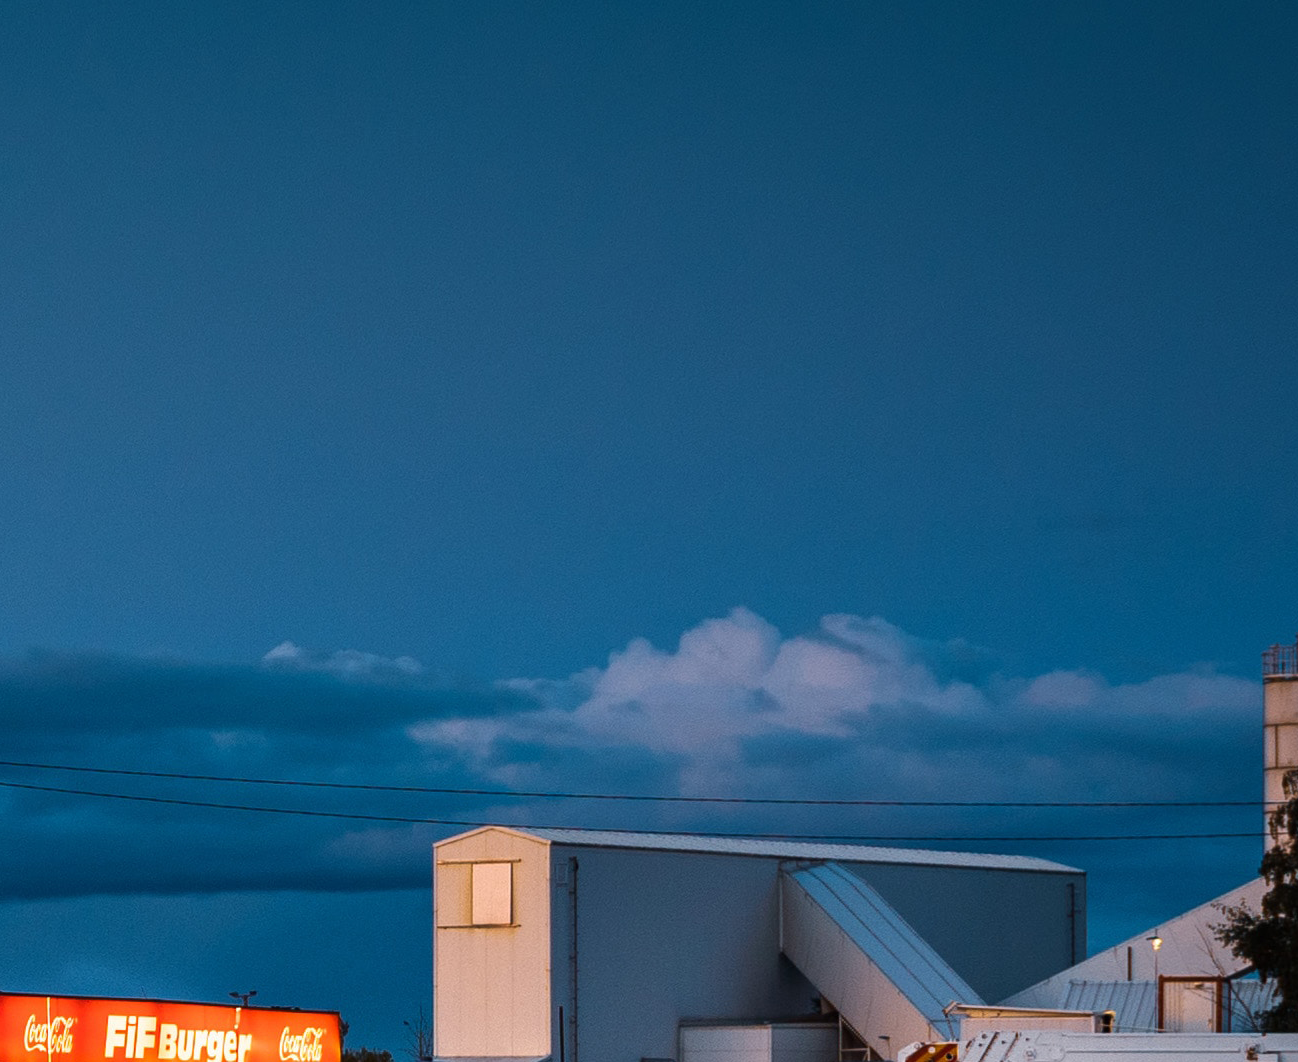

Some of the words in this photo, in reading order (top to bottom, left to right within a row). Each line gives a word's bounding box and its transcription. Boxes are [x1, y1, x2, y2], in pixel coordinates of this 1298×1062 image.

[23, 1014, 75, 1053] Coca-Cola
[104, 1014, 157, 1059] FiF
[279, 1026, 324, 1062] Coca-Cola
